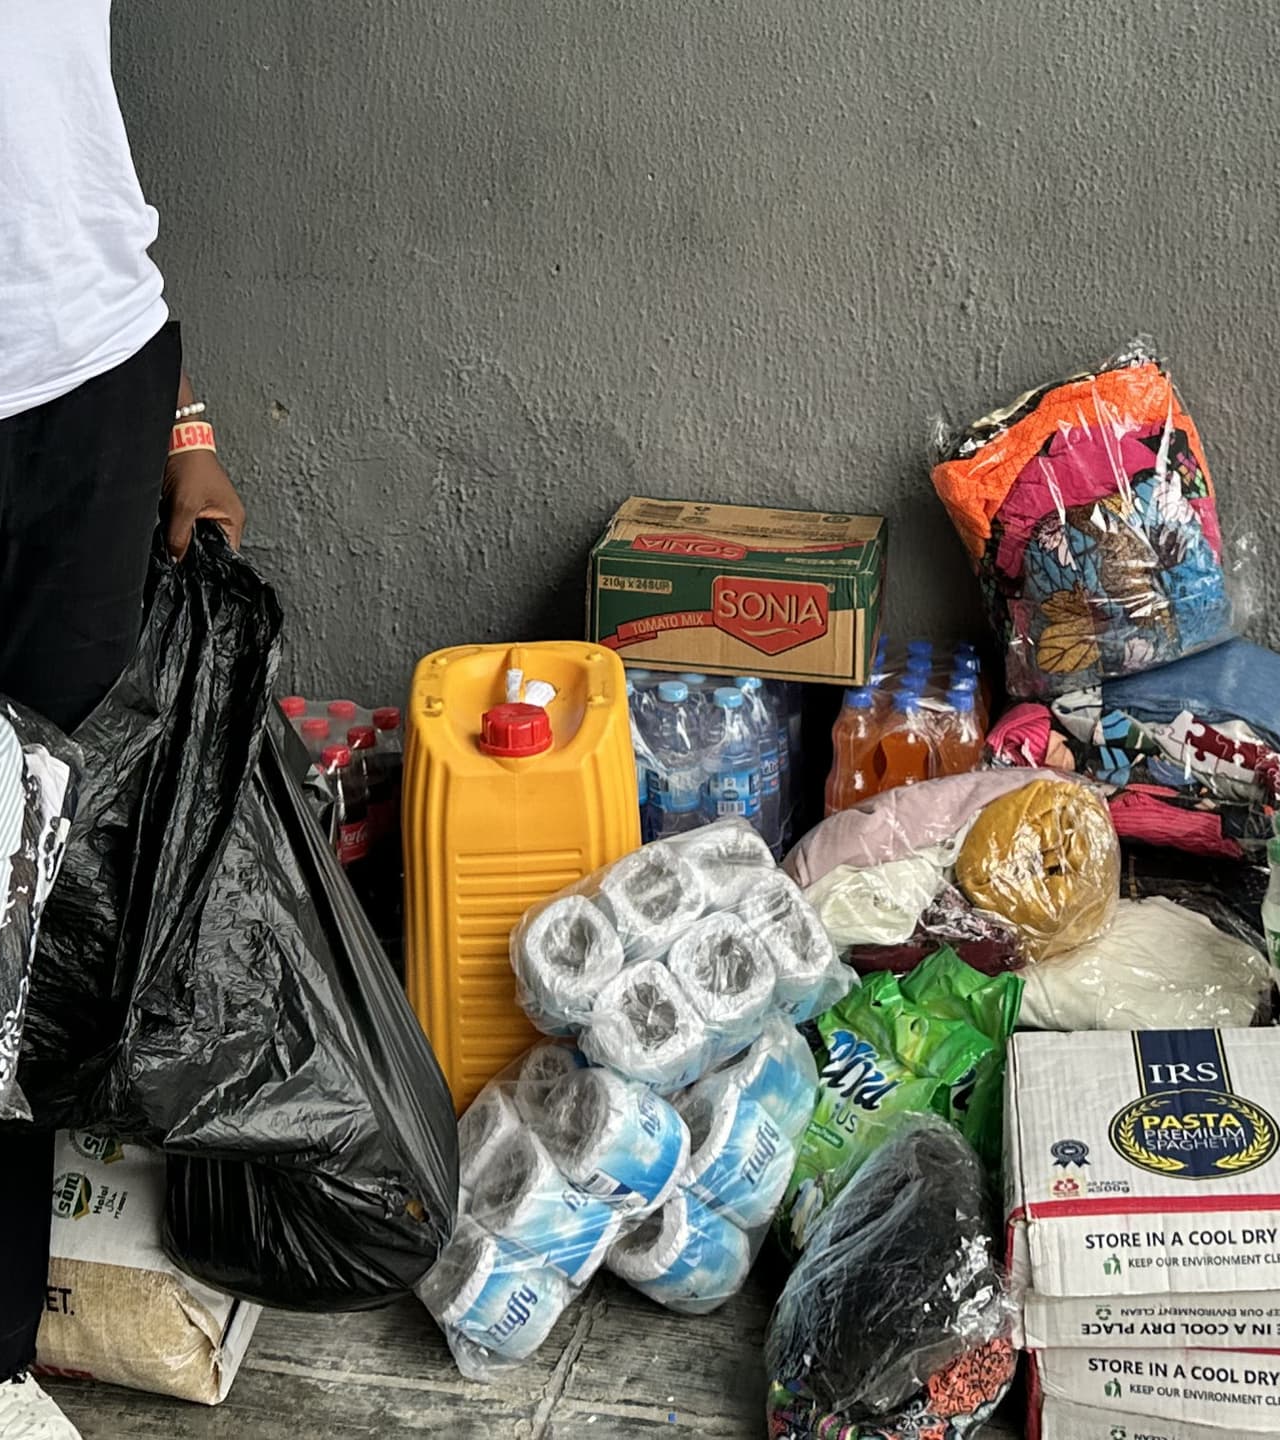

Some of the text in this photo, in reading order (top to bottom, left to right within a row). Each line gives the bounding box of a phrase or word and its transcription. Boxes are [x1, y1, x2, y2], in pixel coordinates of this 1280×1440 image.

[641, 536, 740, 558] SONIA
[719, 589, 824, 626] SONIA
[631, 613, 704, 635] TOMATO MIX
[1148, 1062, 1219, 1085] IRS
[1142, 1112, 1242, 1129] PASTA
[1144, 1126, 1246, 1141] PREMIUM
[1145, 1136, 1247, 1151] SPAGHETTI
[741, 1120, 781, 1186] Fluffy
[93, 1185, 109, 1215] Halal
[1086, 1233, 1140, 1249] STORE
[1147, 1232, 1165, 1246] IN
[1171, 1231, 1184, 1246] A
[1189, 1230, 1236, 1246] COOL
[1242, 1228, 1277, 1244] DRY
[1128, 1258, 1153, 1268] KEEP
[1157, 1257, 1179, 1268] OUR
[1182, 1254, 1261, 1267] ENVIRONMENT
[46, 1287, 75, 1315] ET.
[487, 1284, 538, 1344] Fluffy
[1121, 1306, 1155, 1316] CLEAN
[1159, 1307, 1237, 1317] ENVIRONMENT
[1242, 1308, 1264, 1317] OUR
[1081, 1323, 1134, 1335] PLACE
[1140, 1323, 1176, 1335] DRY
[1181, 1323, 1229, 1335] COOL
[1235, 1323, 1248, 1335] A
[1253, 1323, 1271, 1335] IN
[1088, 1358, 1143, 1375] STORE
[1149, 1362, 1168, 1377] IN
[1174, 1365, 1186, 1378] A
[1191, 1366, 1239, 1384] COOL
[1244, 1370, 1280, 1387] DRY
[1129, 1384, 1154, 1395] KEEP
[1157, 1386, 1180, 1398] OUR
[1183, 1388, 1261, 1406] ENVIRONMENT
